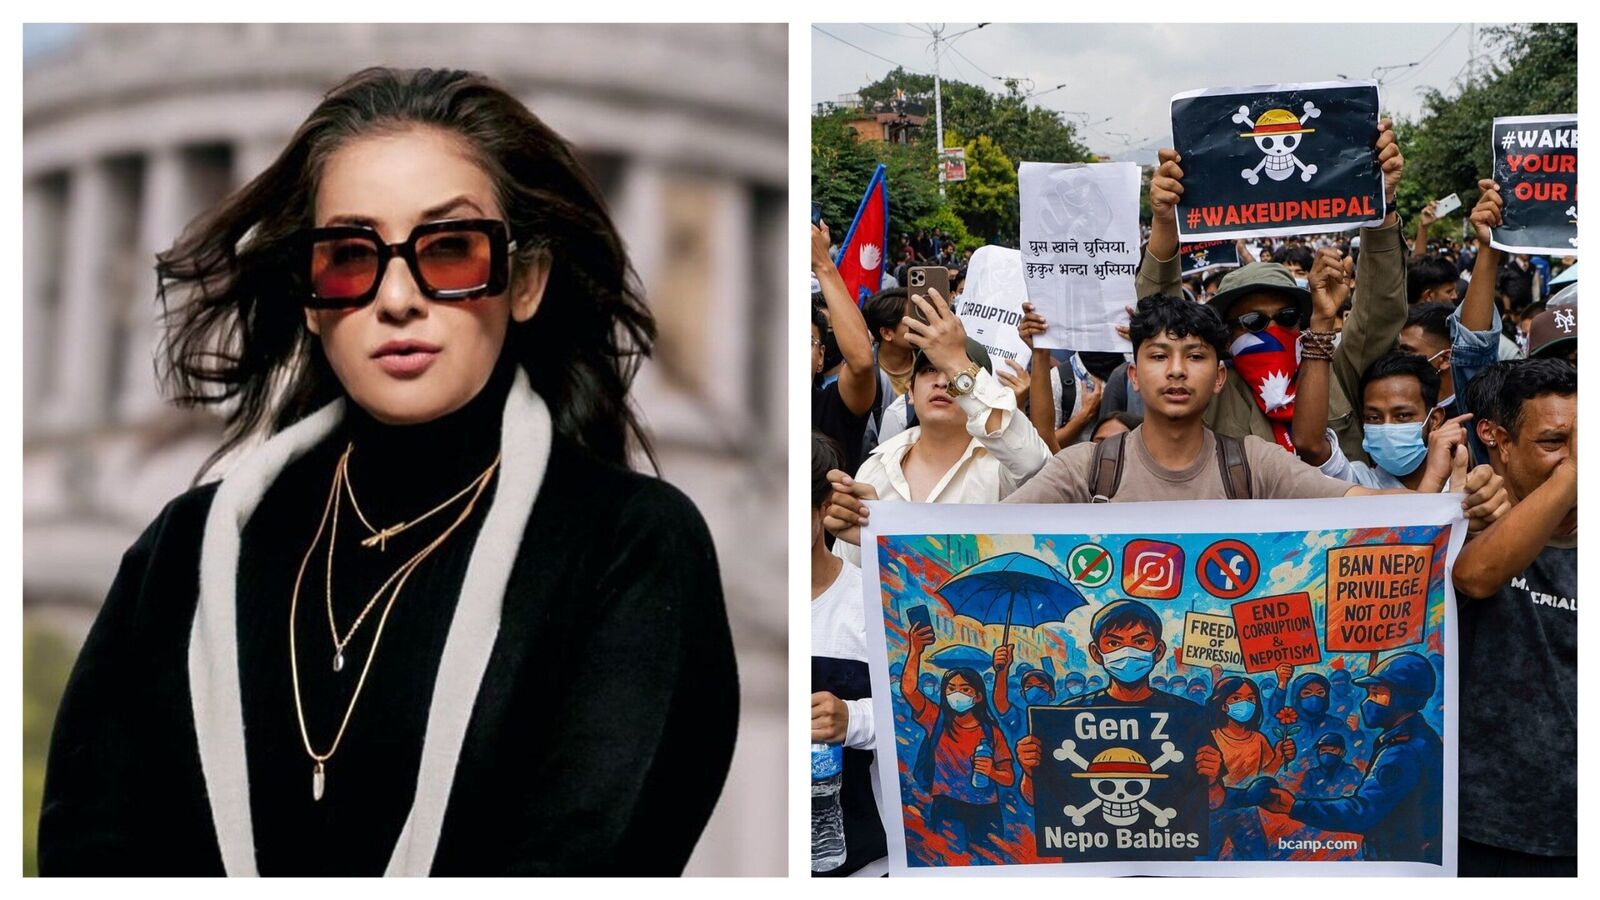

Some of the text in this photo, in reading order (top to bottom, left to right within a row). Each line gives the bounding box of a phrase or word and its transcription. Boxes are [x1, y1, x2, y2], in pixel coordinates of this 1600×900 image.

[1506, 153, 1576, 173] YOUR
[1515, 182, 1567, 201] OUR
[1187, 195, 1376, 230] #WAKEUPNEPAL
[1029, 241, 1048, 256] घुस
[1051, 238, 1079, 254] खाने
[1026, 262, 1055, 279] कुकुर
[1059, 263, 1089, 276] भन्दा
[1338, 553, 1426, 577] BAN NEPO
[1336, 577, 1424, 601] PRIVILEGE,
[1251, 601, 1290, 621] END
[1344, 601, 1412, 622] NOT OUR
[1191, 620, 1238, 639] FREED
[1242, 616, 1311, 640] CORRUPTION
[1340, 621, 1408, 644] VOICES
[1209, 638, 1225, 648] OF
[1272, 635, 1284, 648] &
[1248, 643, 1314, 666] NEPOTISM
[1074, 711, 1170, 741] Gen Z
[1044, 826, 1200, 853] Nepo Babies
[1278, 836, 1358, 853] bcanp.com
